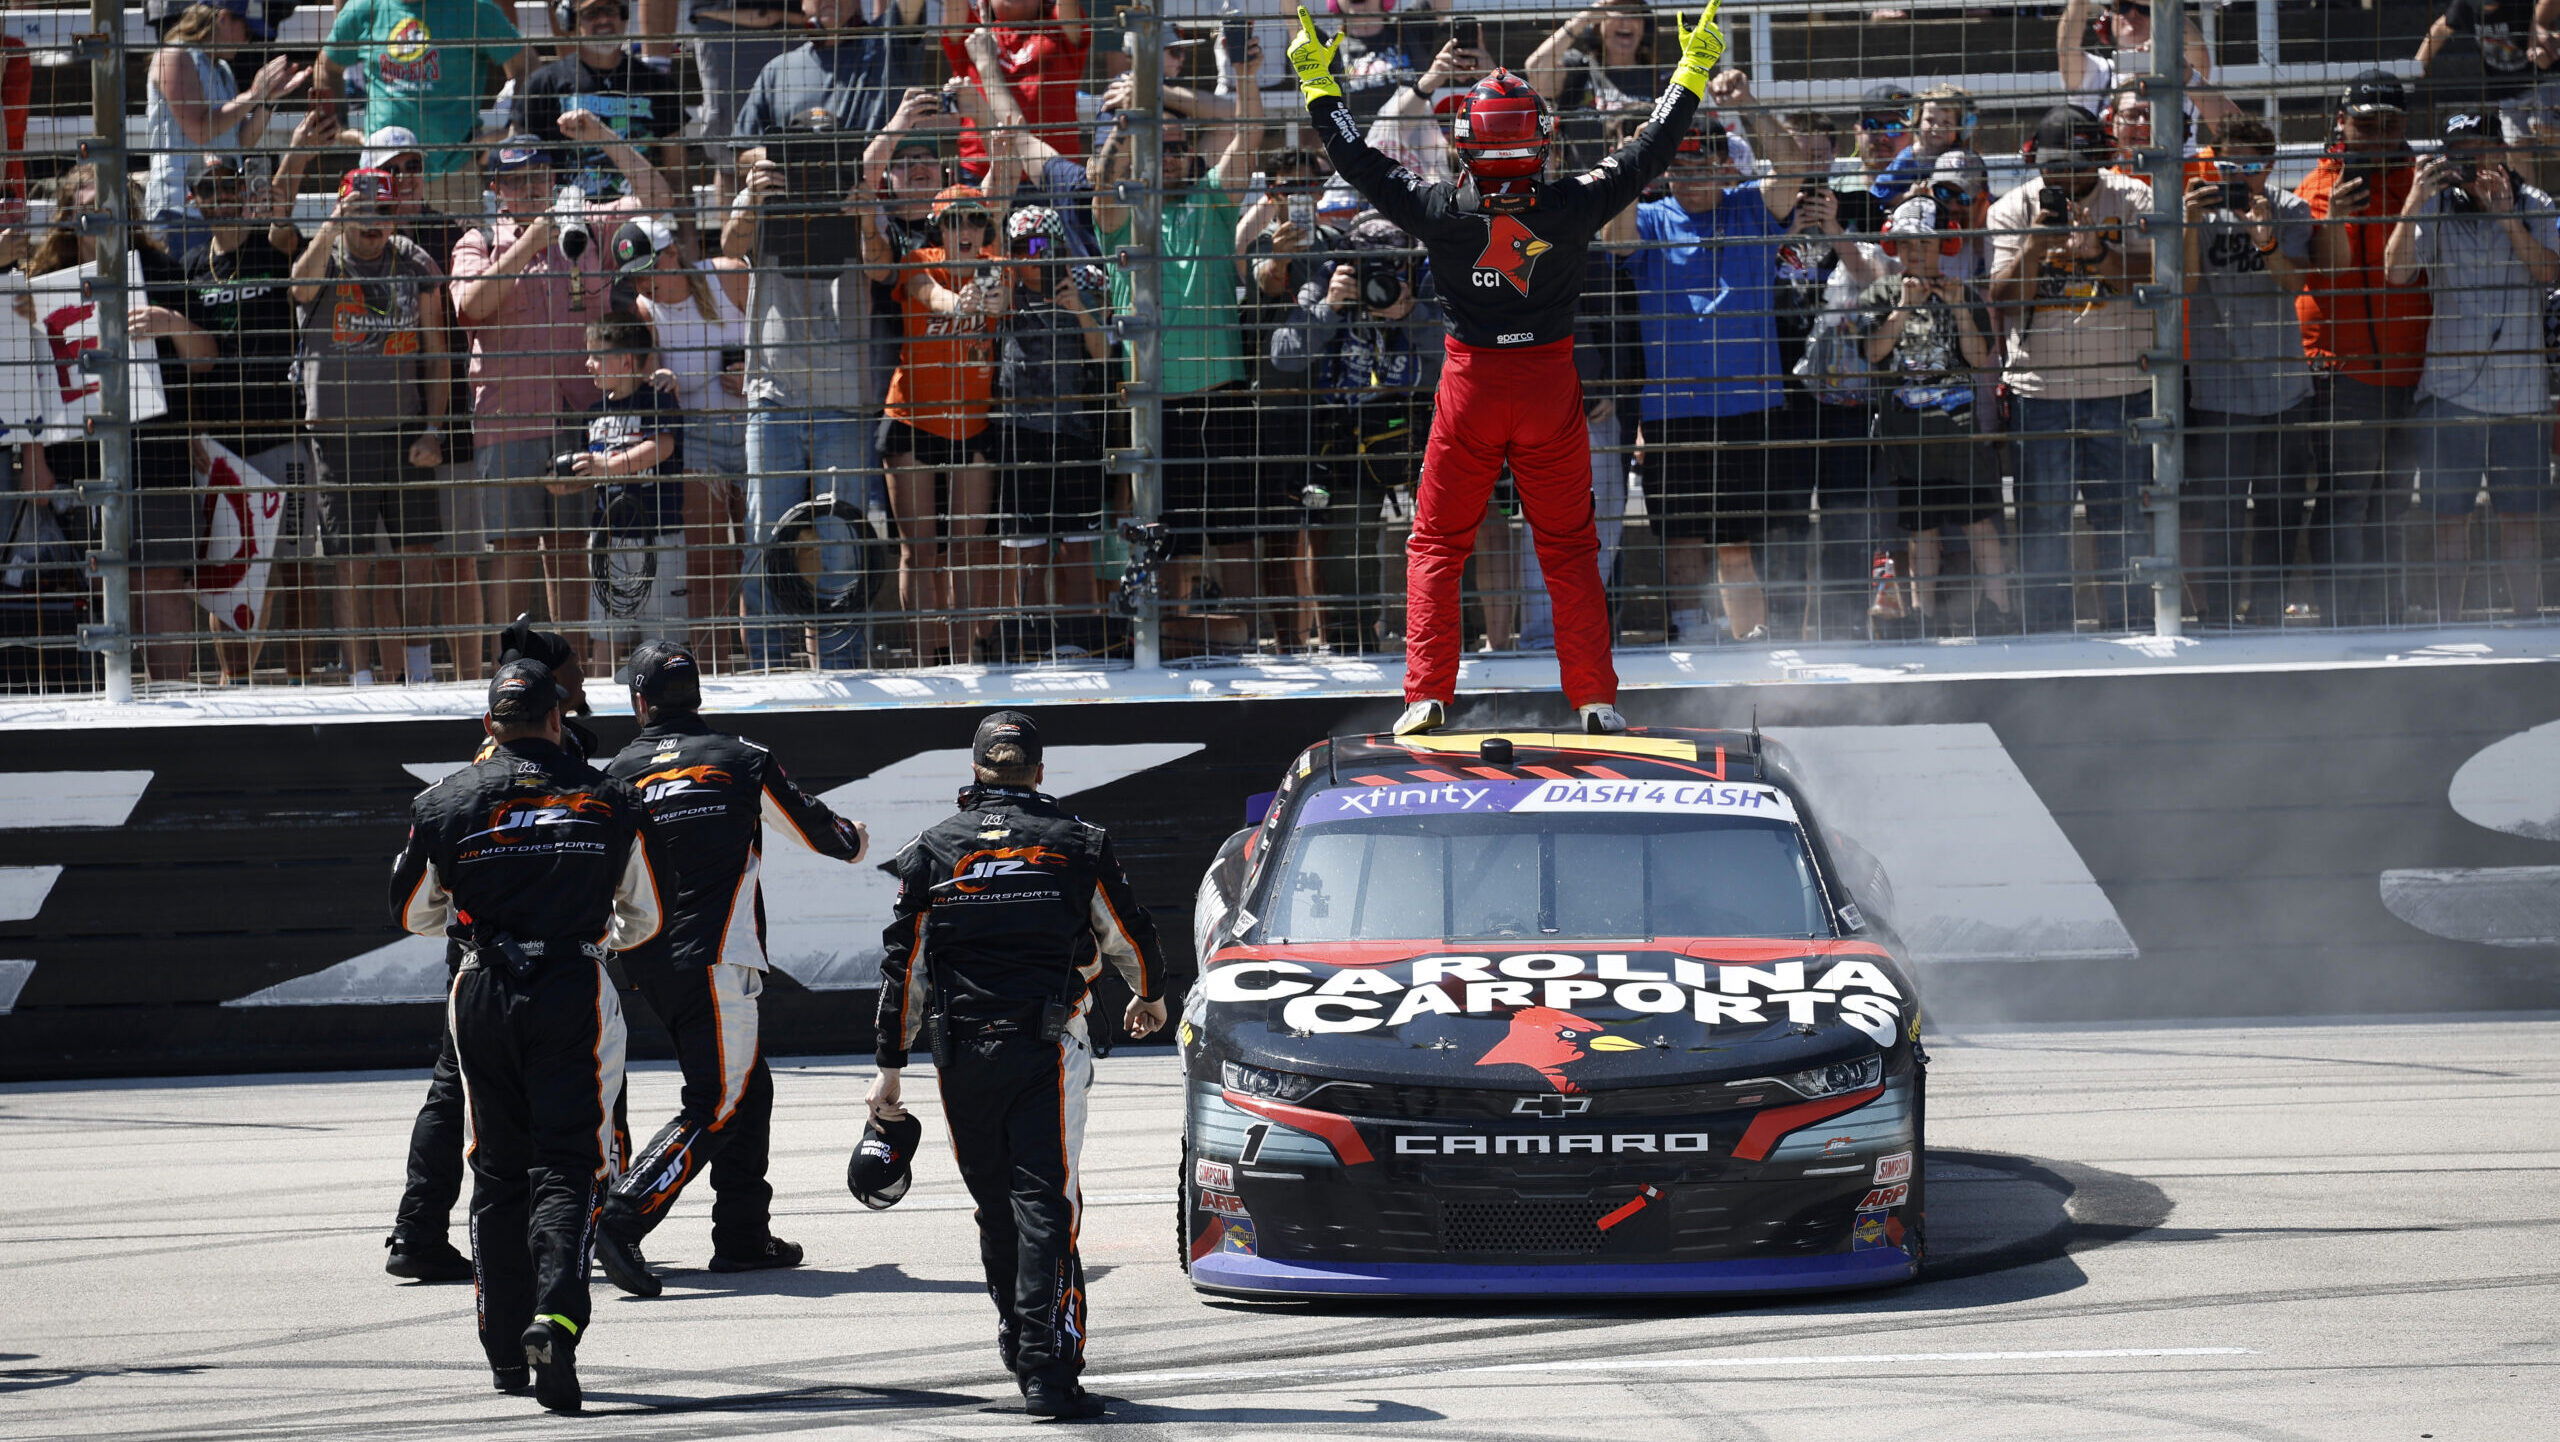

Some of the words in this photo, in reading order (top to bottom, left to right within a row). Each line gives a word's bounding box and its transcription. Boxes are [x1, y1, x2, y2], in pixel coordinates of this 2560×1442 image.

[1472, 272, 1500, 287] CCI
[1496, 331, 1534, 344] sparco
[1339, 784, 1491, 814] xfinity
[1543, 785, 1641, 804] DASH
[1644, 786, 1666, 804] 4
[1674, 786, 1764, 809] CASH
[1206, 952, 1903, 1004] CAROLINA
[1283, 978, 1900, 1048] CARPORTS
[1238, 1122, 1274, 1166] 1
[1395, 1132, 1709, 1155] CAMARO
[1198, 1164, 1230, 1188] SIMPSON
[1878, 1155, 1911, 1181] SIMPSON
[1201, 1190, 1245, 1213] ARP
[1861, 1184, 1908, 1207] ARP
[1226, 1230, 1255, 1243] SUNOCO
[1855, 1223, 1885, 1239] SUNOCO
